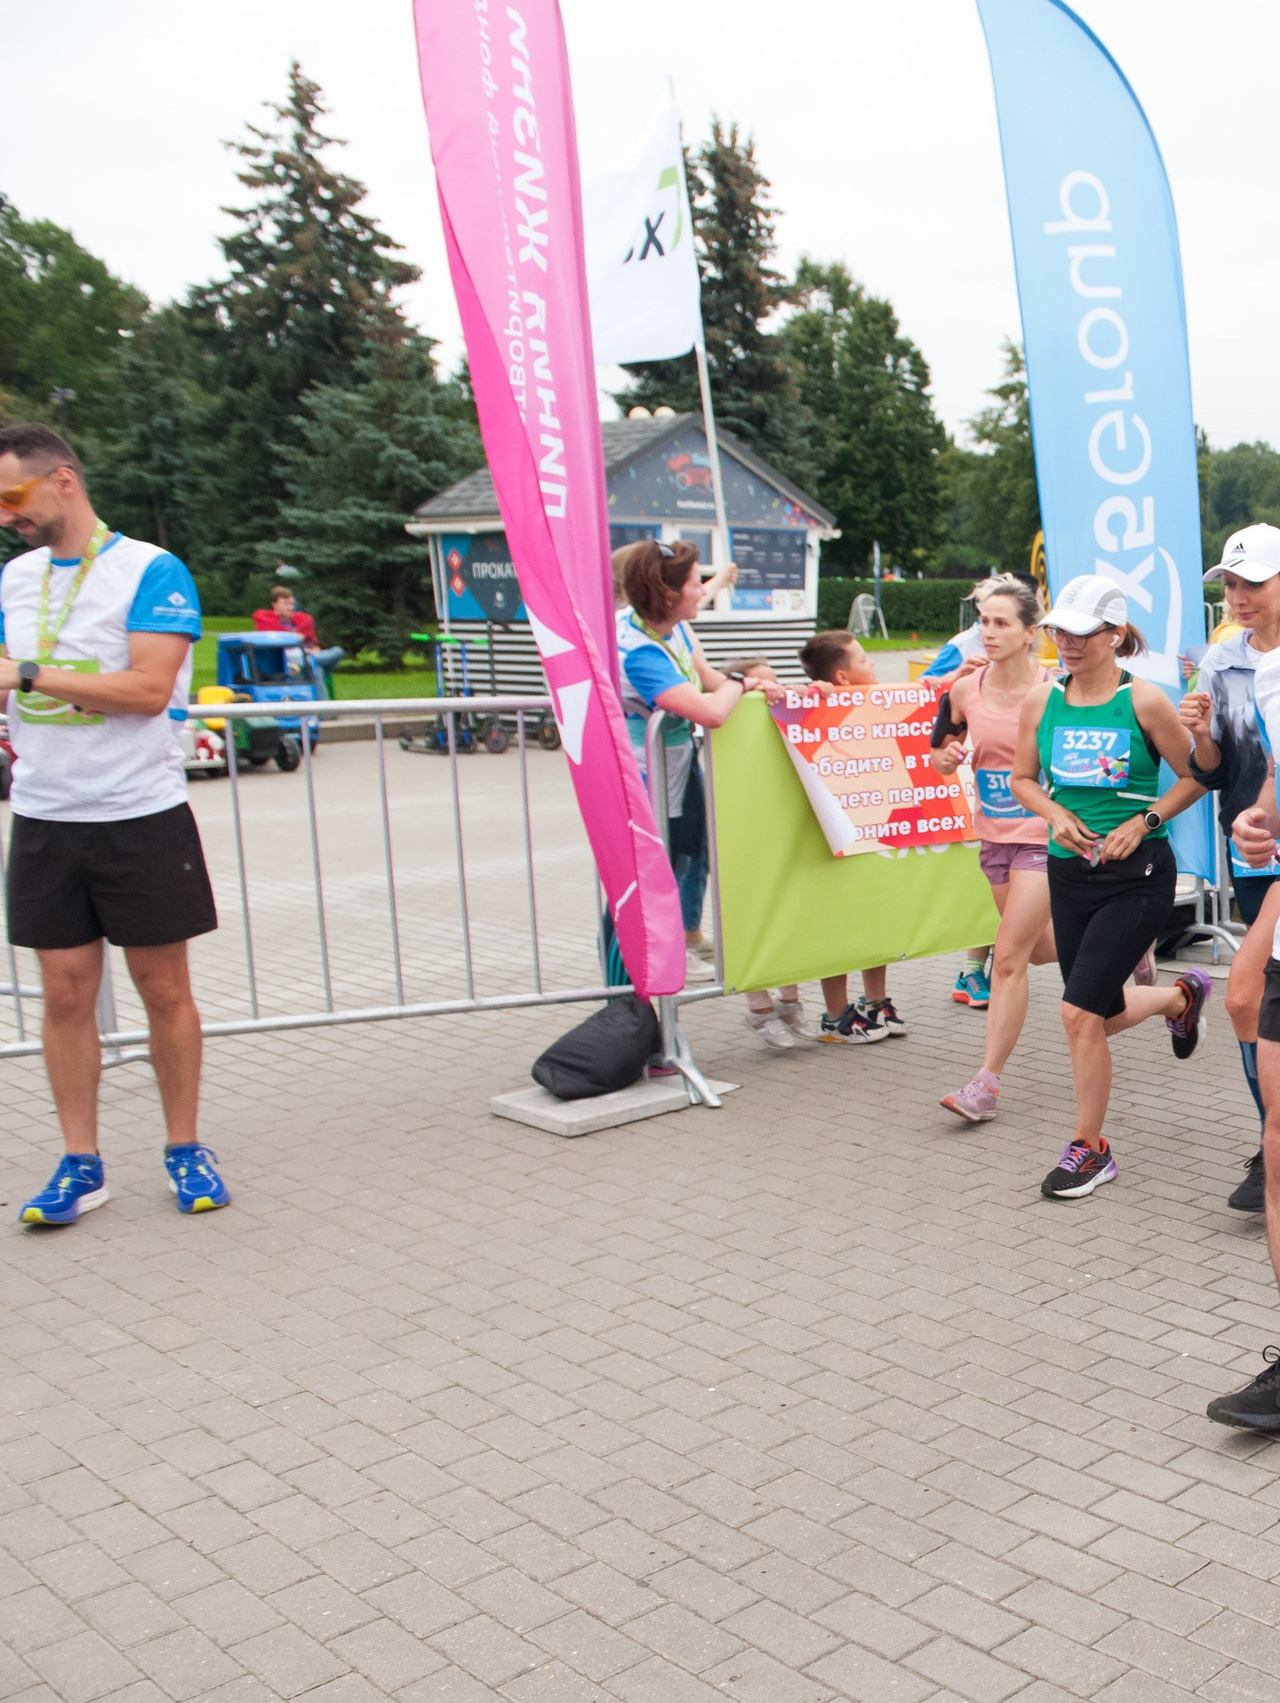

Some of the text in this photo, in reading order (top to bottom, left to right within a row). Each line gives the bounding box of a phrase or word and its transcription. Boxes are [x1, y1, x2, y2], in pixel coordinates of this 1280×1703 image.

[785, 688, 937, 710] Вы все супер!
[786, 723, 821, 744] Вы
[827, 724, 866, 742] все
[1062, 730, 1118, 751] 3237
[808, 755, 893, 778] обедите
[905, 754, 917, 770] в
[888, 782, 961, 807] первое
[853, 820, 911, 841] оните
[917, 813, 966, 833] всех
